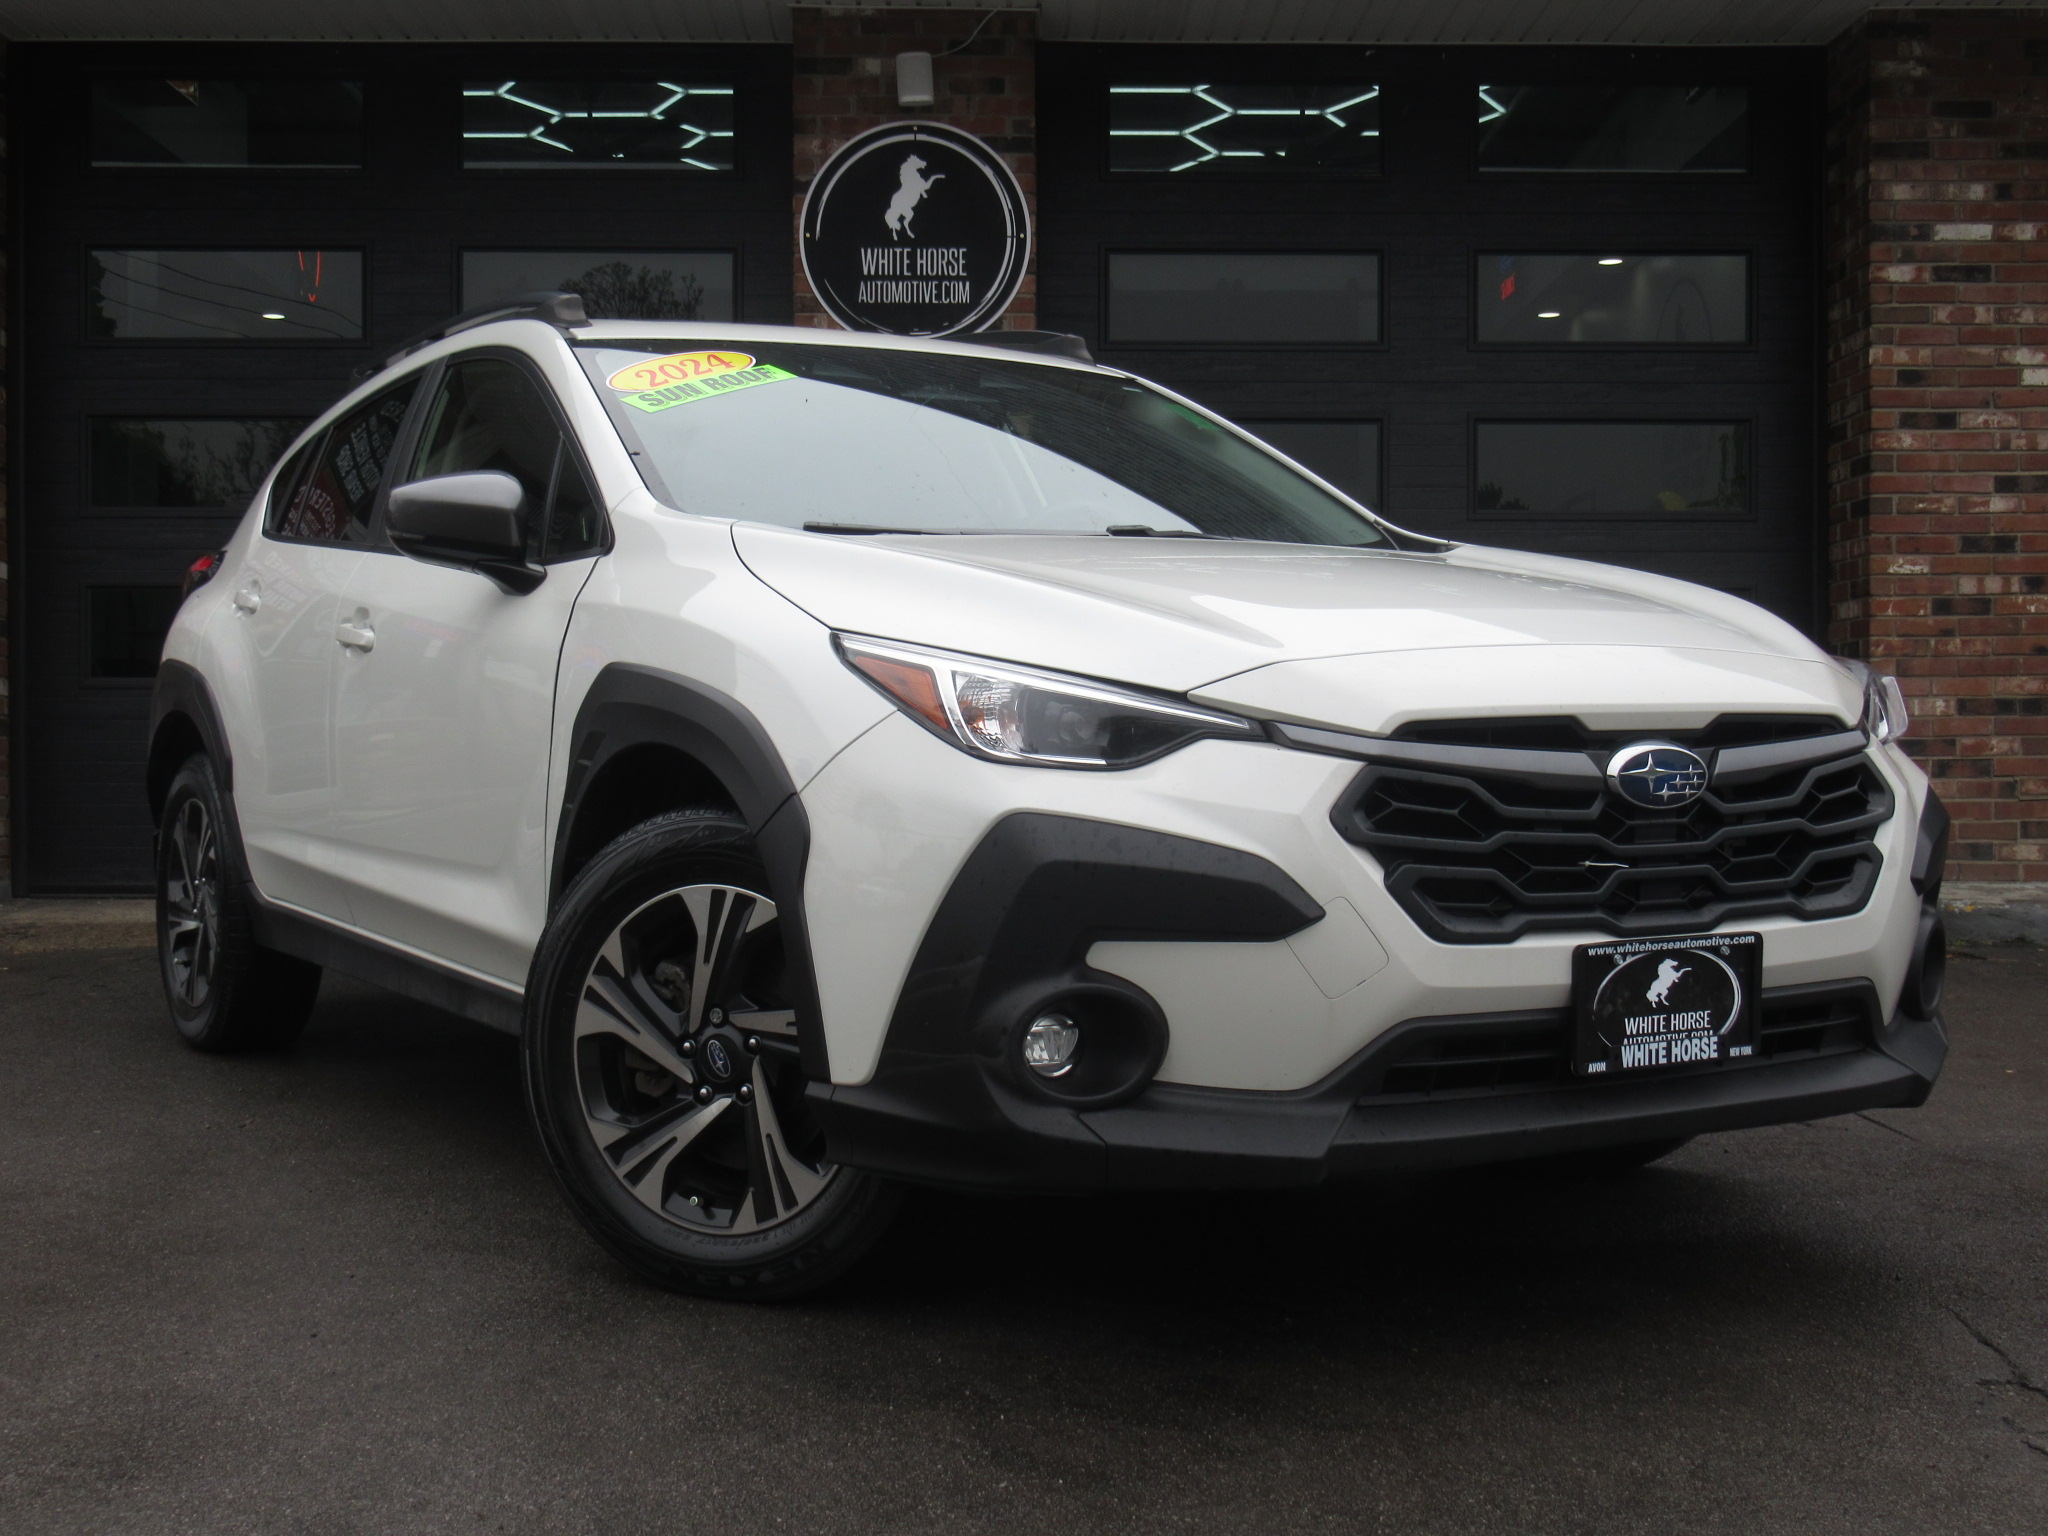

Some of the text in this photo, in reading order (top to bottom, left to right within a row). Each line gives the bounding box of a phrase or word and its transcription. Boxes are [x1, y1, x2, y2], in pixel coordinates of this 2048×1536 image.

[861, 247, 967, 276] WHITE HORSE
[858, 281, 970, 304] AUTOMOTIVE.COM
[635, 353, 734, 388] 2024
[638, 367, 776, 407] SUN ROOF
[1588, 935, 1755, 955] www.whitehorseautomotive.com
[1624, 1011, 1711, 1036] WHITE HORSE
[1621, 1036, 1718, 1068] WHITE HORSE
[1588, 1061, 1606, 1073] AVON
